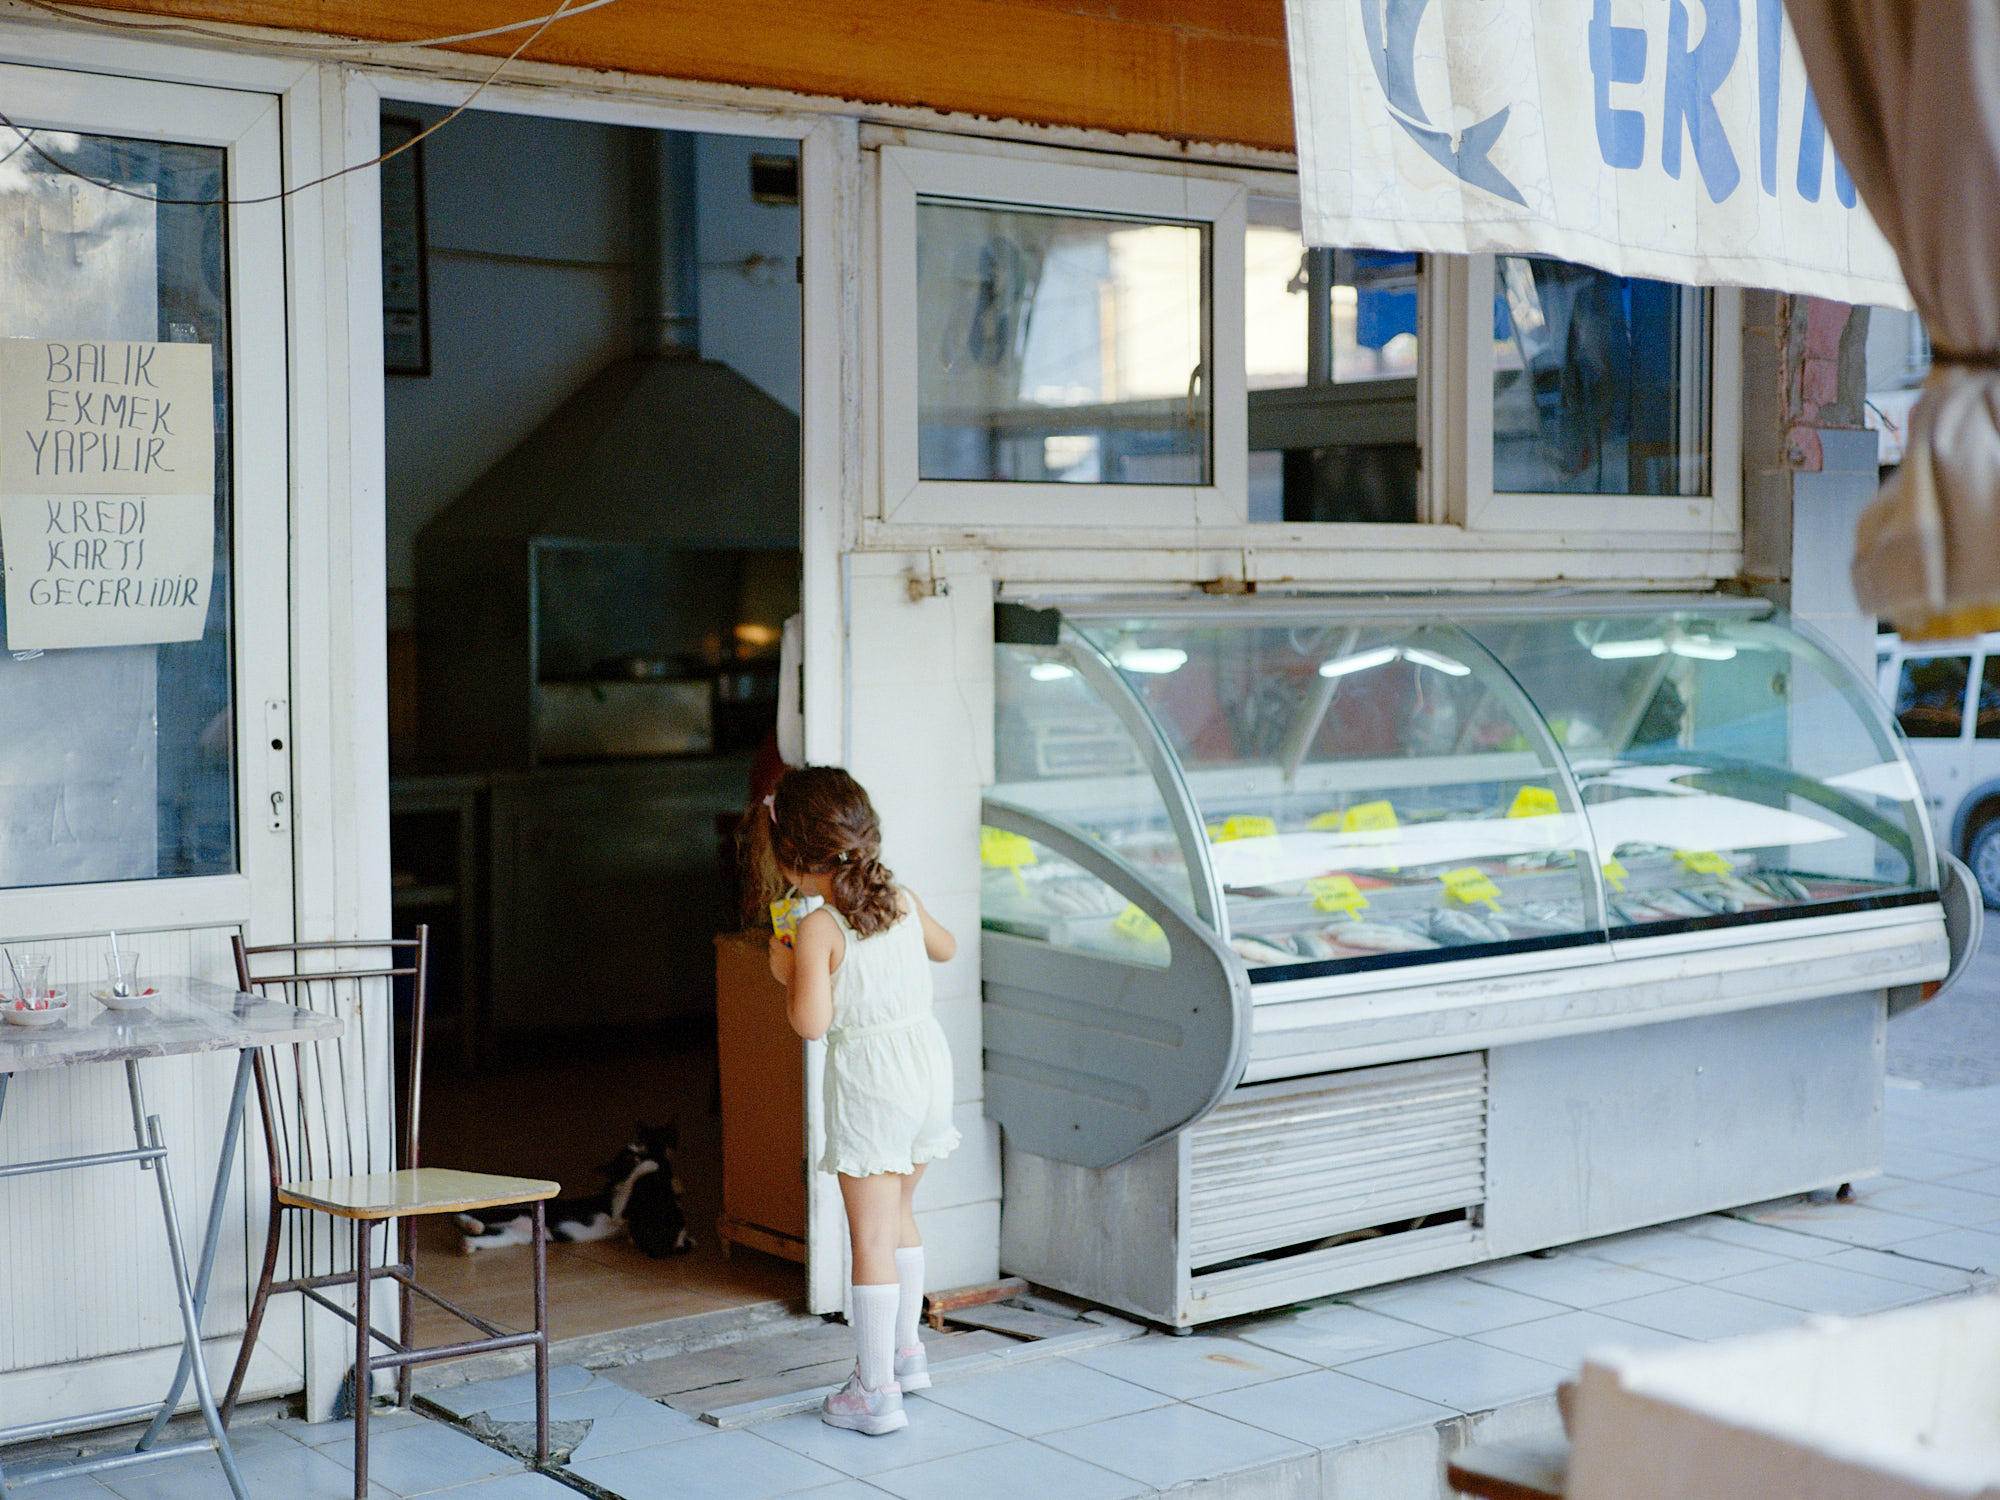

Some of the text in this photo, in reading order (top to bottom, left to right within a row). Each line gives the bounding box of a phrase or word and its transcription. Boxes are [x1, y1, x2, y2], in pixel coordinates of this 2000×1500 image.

[1588, 0, 1857, 210] ERI
[46, 343, 159, 388] BALIK
[46, 389, 176, 435] EKMEK
[26, 429, 176, 475] YAPILIR
[47, 538, 144, 572] KARTI
